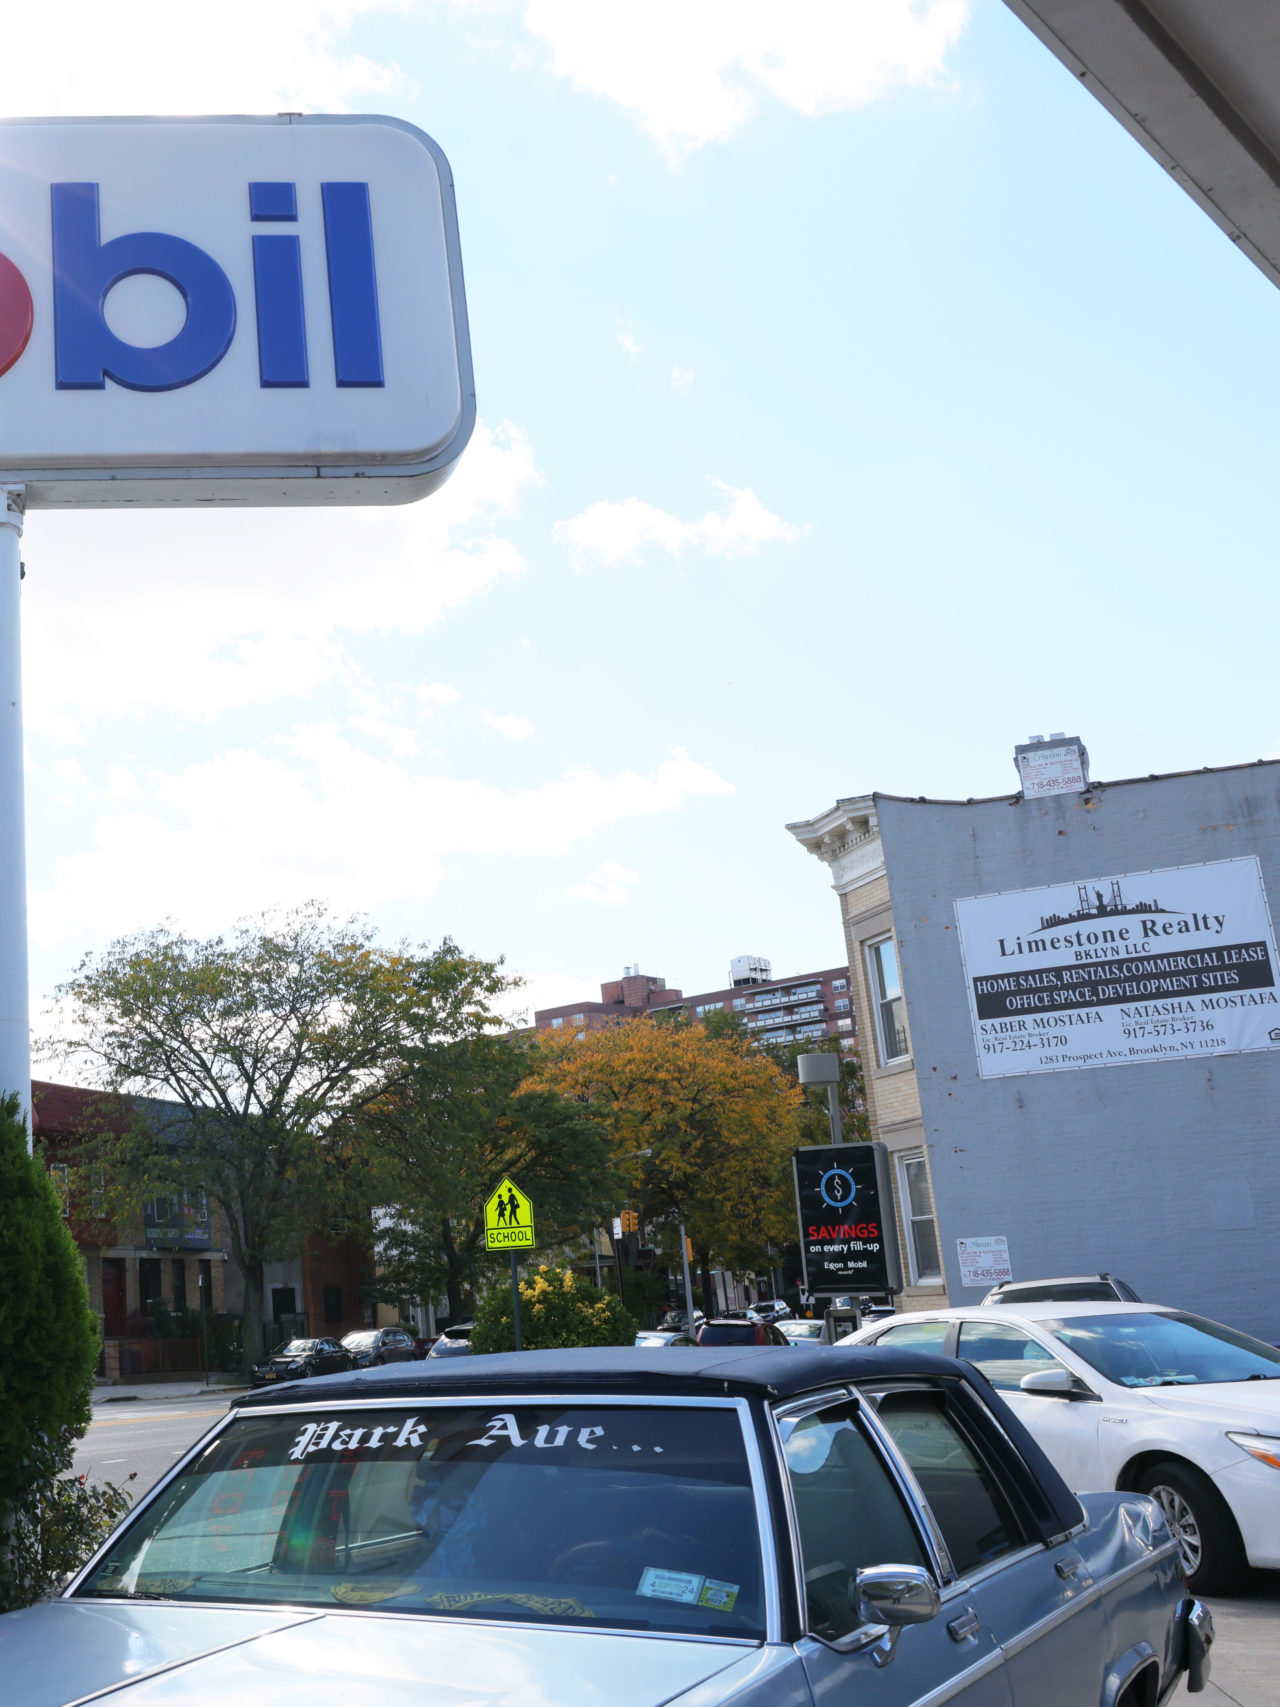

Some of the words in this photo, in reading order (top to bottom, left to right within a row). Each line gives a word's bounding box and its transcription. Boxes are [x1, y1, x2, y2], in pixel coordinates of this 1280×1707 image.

[997, 926, 1130, 957] Limestone
[1140, 912, 1226, 939] Realty
[1074, 945, 1120, 961] BKLYN
[1125, 941, 1151, 955] LLC
[976, 977, 1018, 995] HOME
[1020, 971, 1061, 990] SALES,
[1224, 946, 1267, 964] LEASE
[1006, 992, 1052, 1010] OFFICE
[1053, 987, 1097, 1004] SPACE,
[1098, 974, 1199, 999] DEVELOPMENT
[1201, 969, 1240, 987] SITES
[1120, 1000, 1196, 1020] NATASHA
[1201, 991, 1279, 1011] MOSTAFA
[980, 1020, 1028, 1036] SABER
[1032, 1010, 1104, 1030] MOSTAFA
[1171, 1014, 1194, 1023] Broker
[1008, 1033, 1027, 1041] Estate
[1123, 1019, 1214, 1039] 917-573-3736
[983, 1034, 1068, 1055] 917-224-3170
[1039, 1054, 1059, 1065] 1283
[1061, 1050, 1103, 1064] Prospect
[1106, 1049, 1127, 1058] Ave,
[1128, 1043, 1179, 1056] Brooklyn,
[1180, 1040, 1195, 1051] NY
[1199, 1037, 1227, 1049] 11218
[489, 1230, 531, 1244] SCHOOL
[808, 1223, 879, 1240] SAVINGS
[823, 1244, 848, 1254] every
[850, 1240, 880, 1252] fill-up
[824, 1261, 844, 1270] Exxon
[847, 1260, 867, 1268] Mobil
[288, 1415, 428, 1461] Park
[680, 1585, 696, 1595] 24
